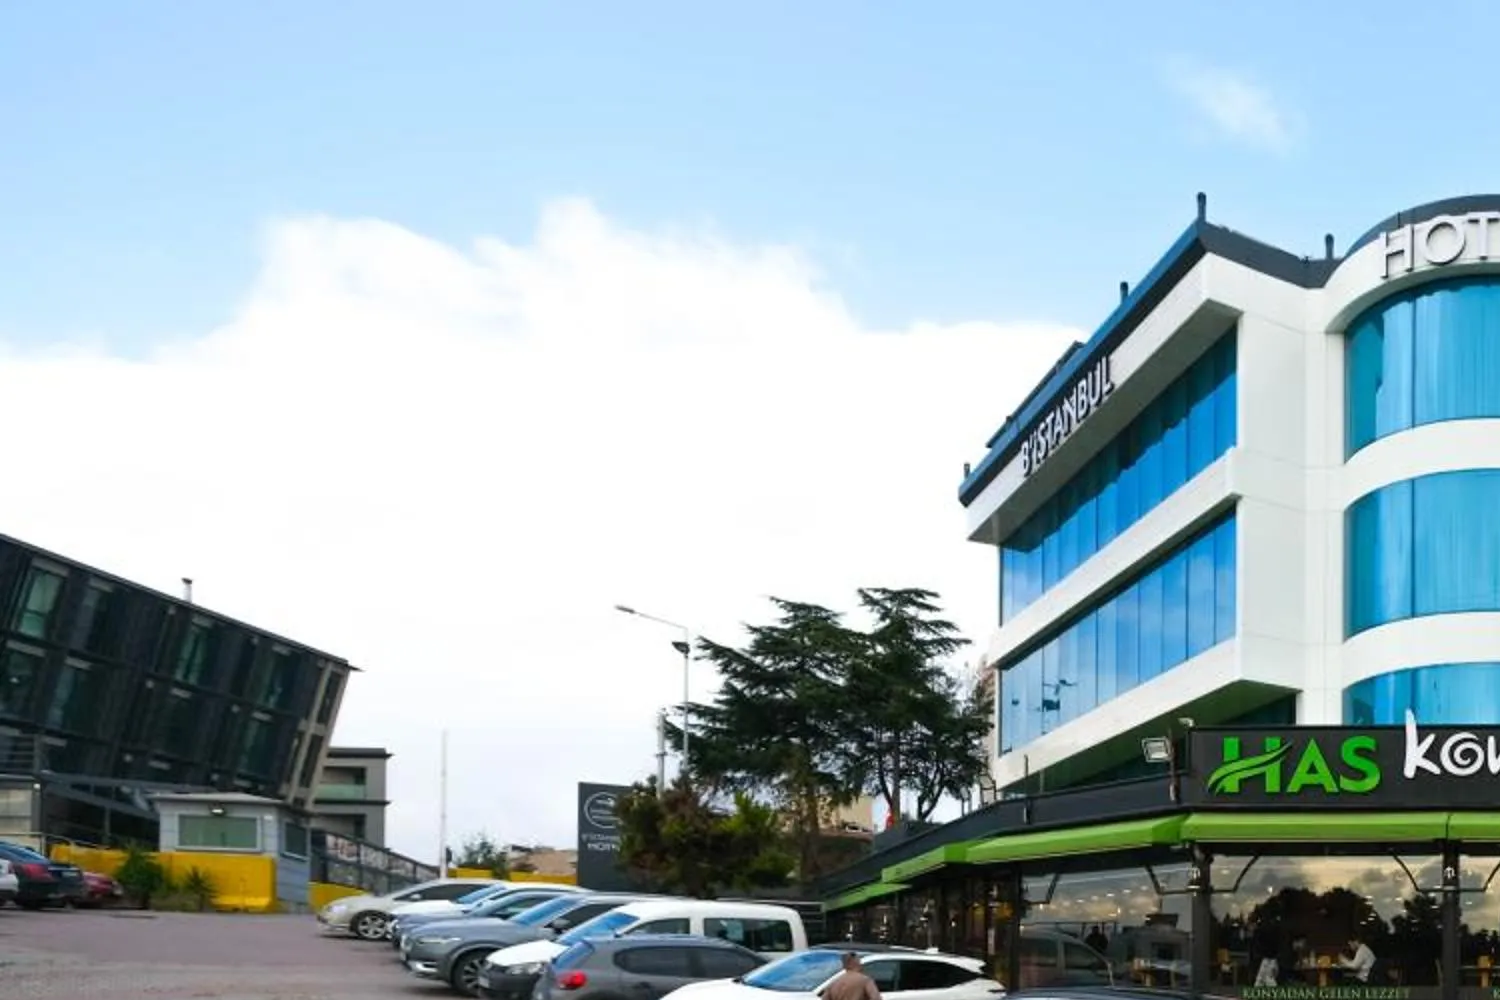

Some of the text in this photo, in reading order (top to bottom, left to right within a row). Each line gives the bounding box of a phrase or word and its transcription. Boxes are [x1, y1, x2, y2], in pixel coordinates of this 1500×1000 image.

[1207, 736, 1380, 794] HAS
[1242, 986, 1411, 1000] KONYADAN GELEN LEZZET
